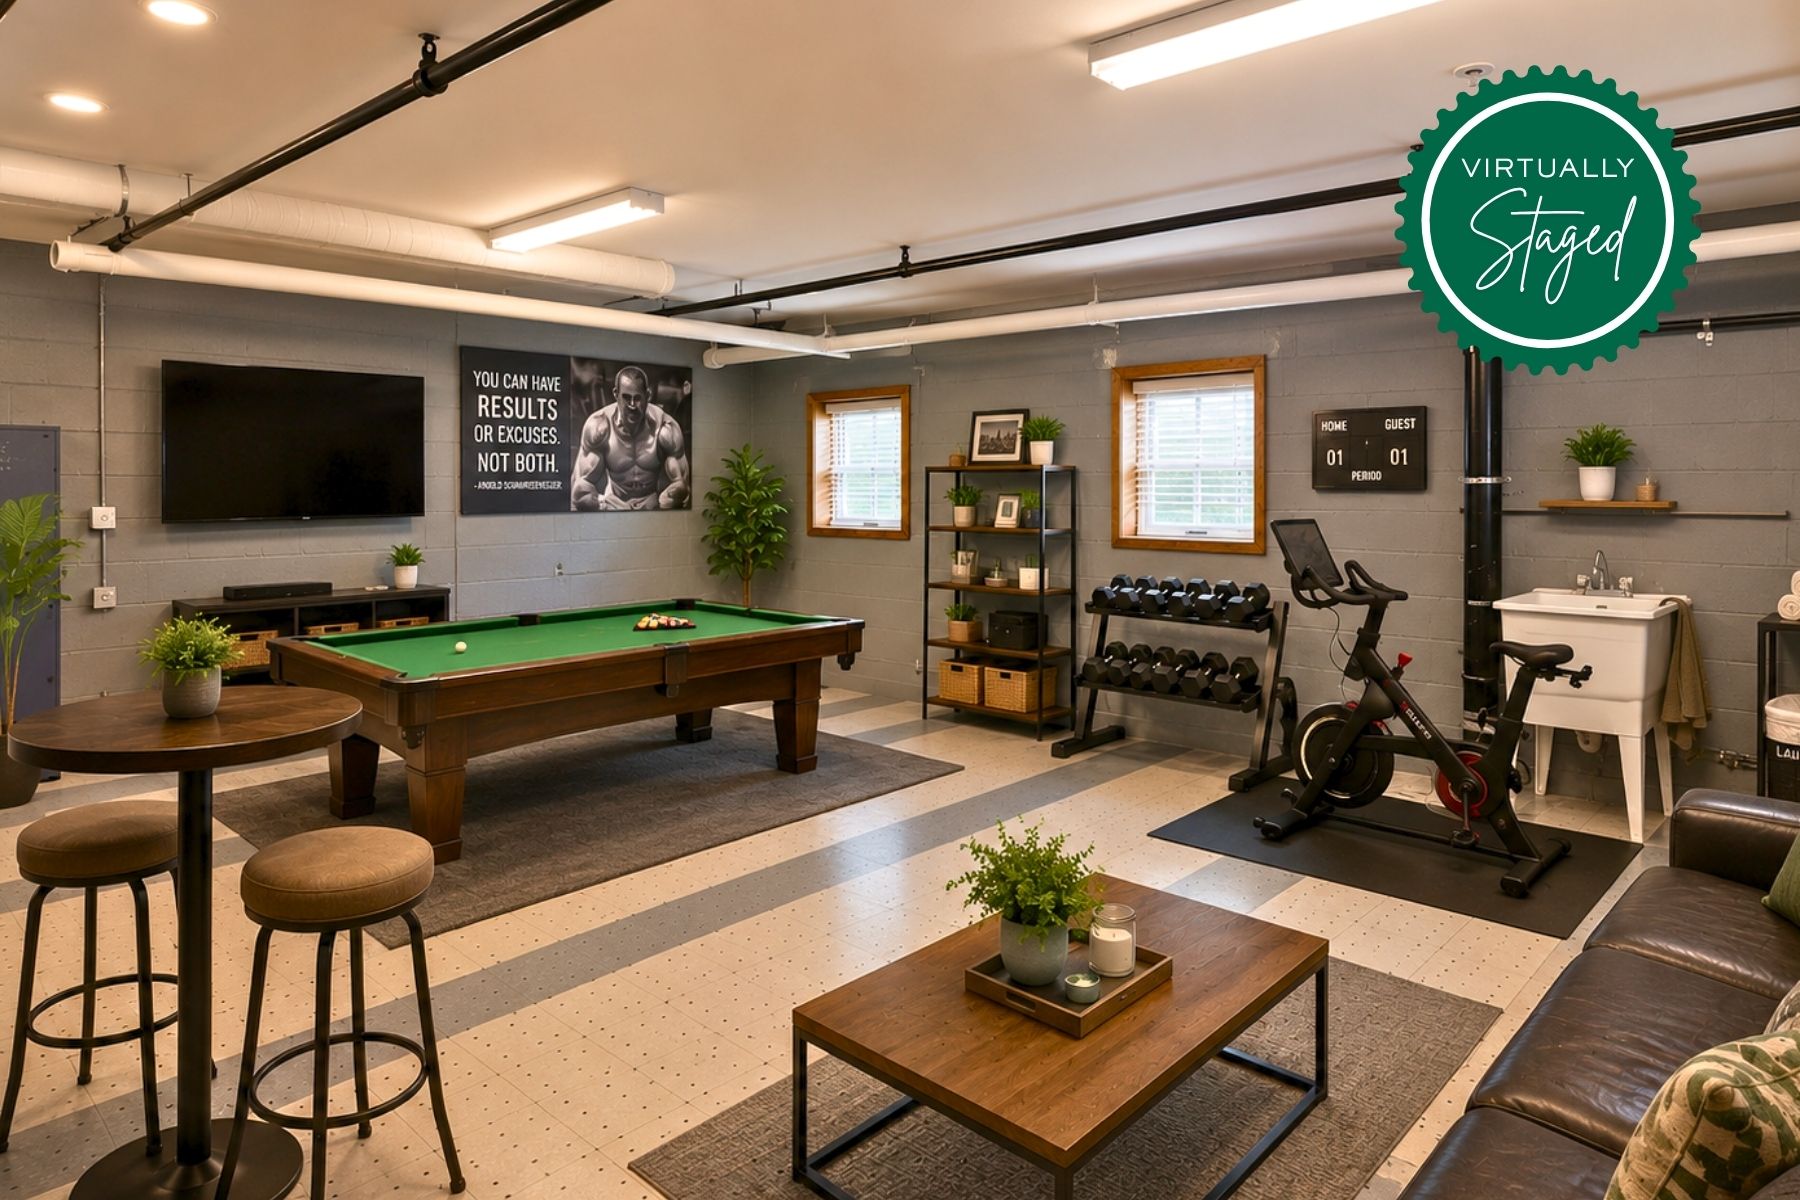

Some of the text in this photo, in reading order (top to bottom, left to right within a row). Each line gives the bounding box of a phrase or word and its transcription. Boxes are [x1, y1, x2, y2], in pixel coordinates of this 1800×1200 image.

[473, 370, 562, 393] YOU CAN HAVE
[478, 394, 558, 422] RESULTS
[1321, 420, 1348, 432] HOME
[1385, 417, 1416, 430] GUEST
[474, 423, 561, 445] OR EXCUSES.
[477, 452, 559, 473] NOT BOTH.
[1326, 448, 1343, 466] 01
[1390, 447, 1408, 466] 01
